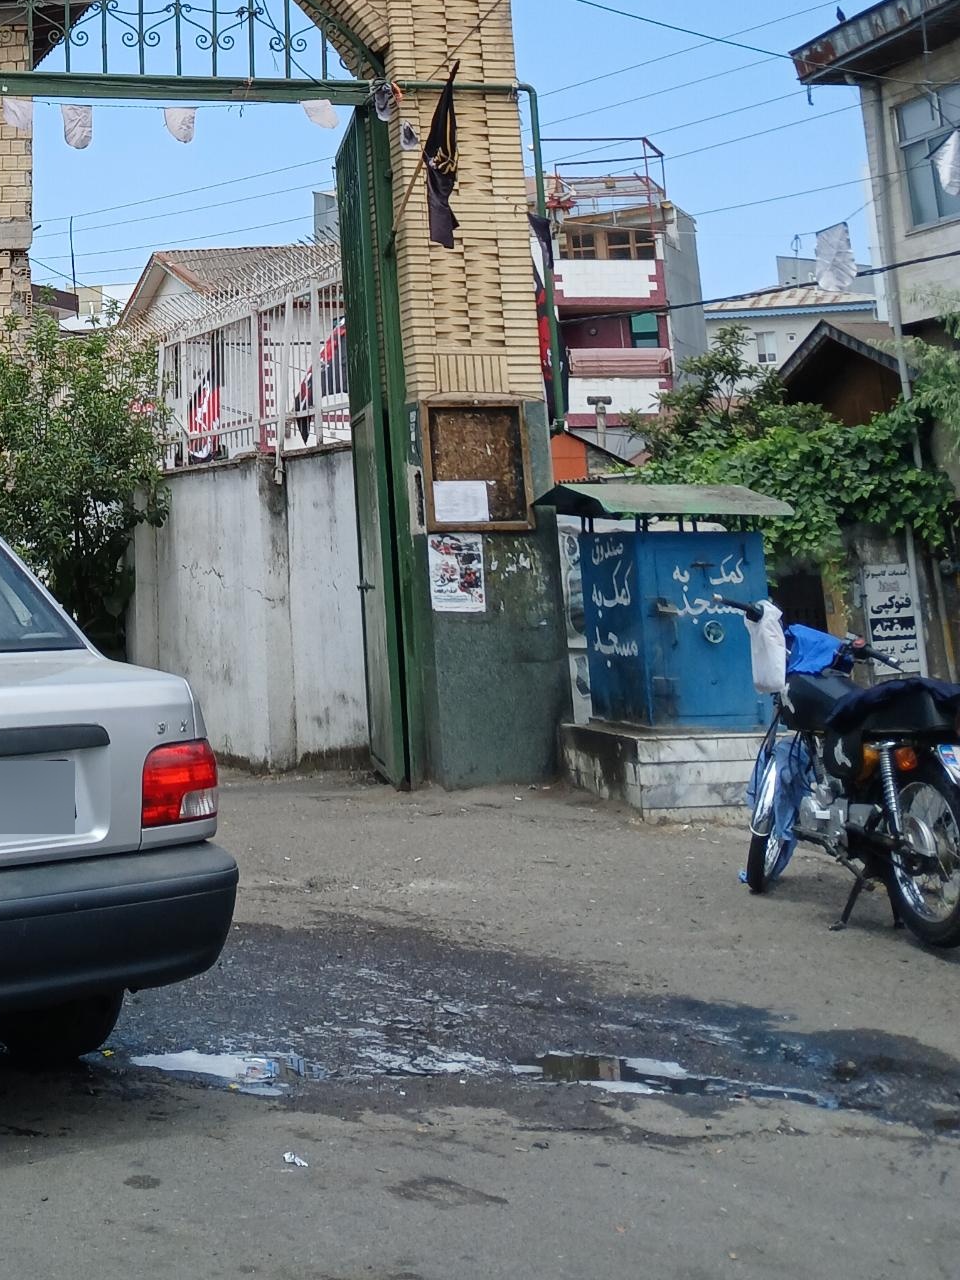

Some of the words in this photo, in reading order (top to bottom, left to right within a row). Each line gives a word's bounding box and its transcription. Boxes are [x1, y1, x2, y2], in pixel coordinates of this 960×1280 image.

[591, 537, 624, 566] صندوق
[602, 559, 634, 609] کمک
[672, 565, 691, 592] به
[709, 553, 745, 586] کمک
[591, 583, 603, 619] به
[870, 592, 913, 615] فتوکپی
[872, 618, 916, 639] سفته
[593, 625, 639, 669] مسجد
